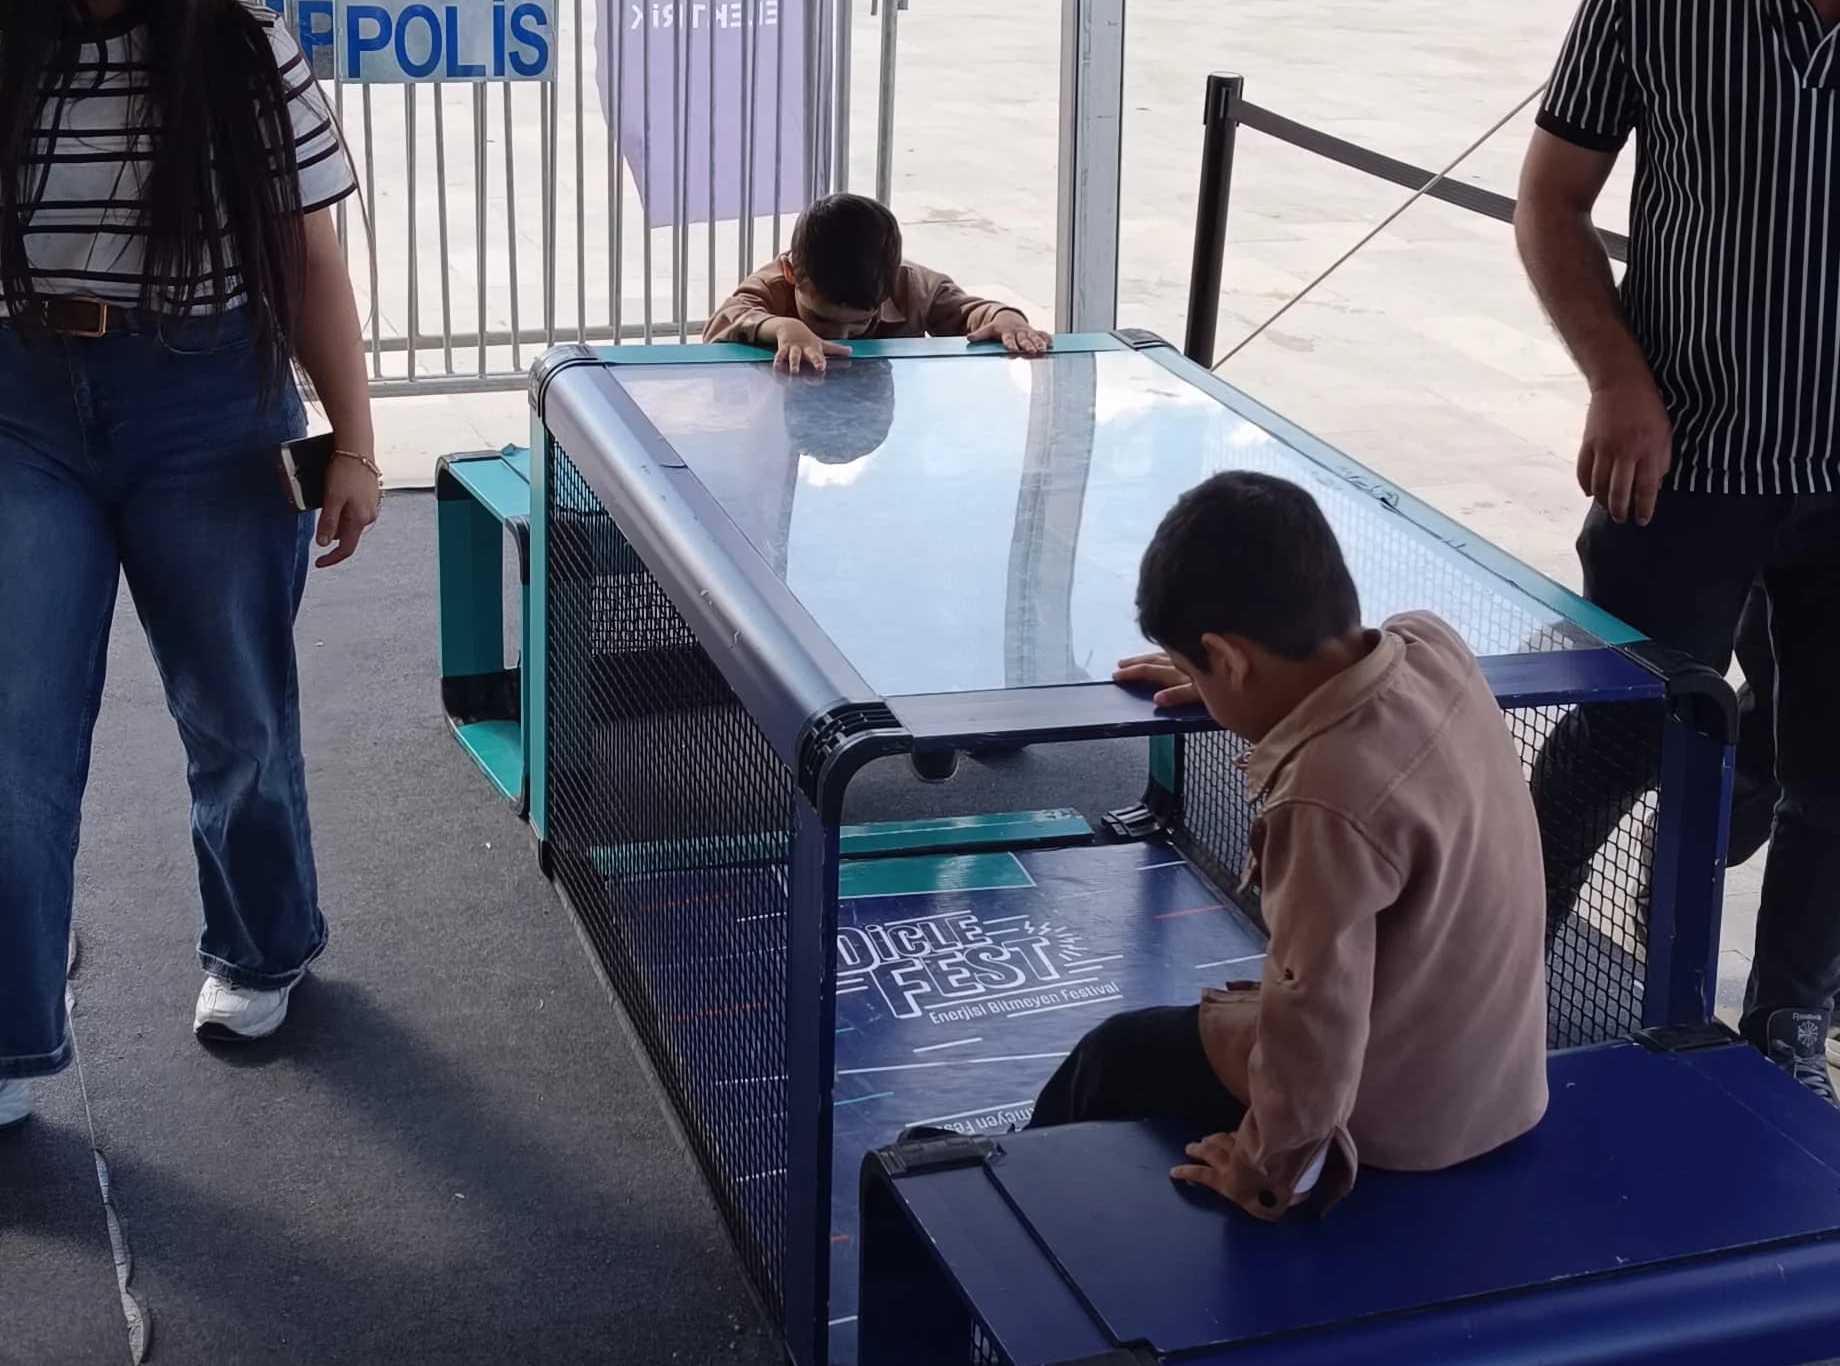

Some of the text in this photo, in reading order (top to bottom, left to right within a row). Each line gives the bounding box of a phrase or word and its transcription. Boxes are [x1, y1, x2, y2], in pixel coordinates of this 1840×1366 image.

[867, 937, 1061, 1019] FEST
[929, 981, 1121, 1025] Enerjisi Bitmeyen Festival
